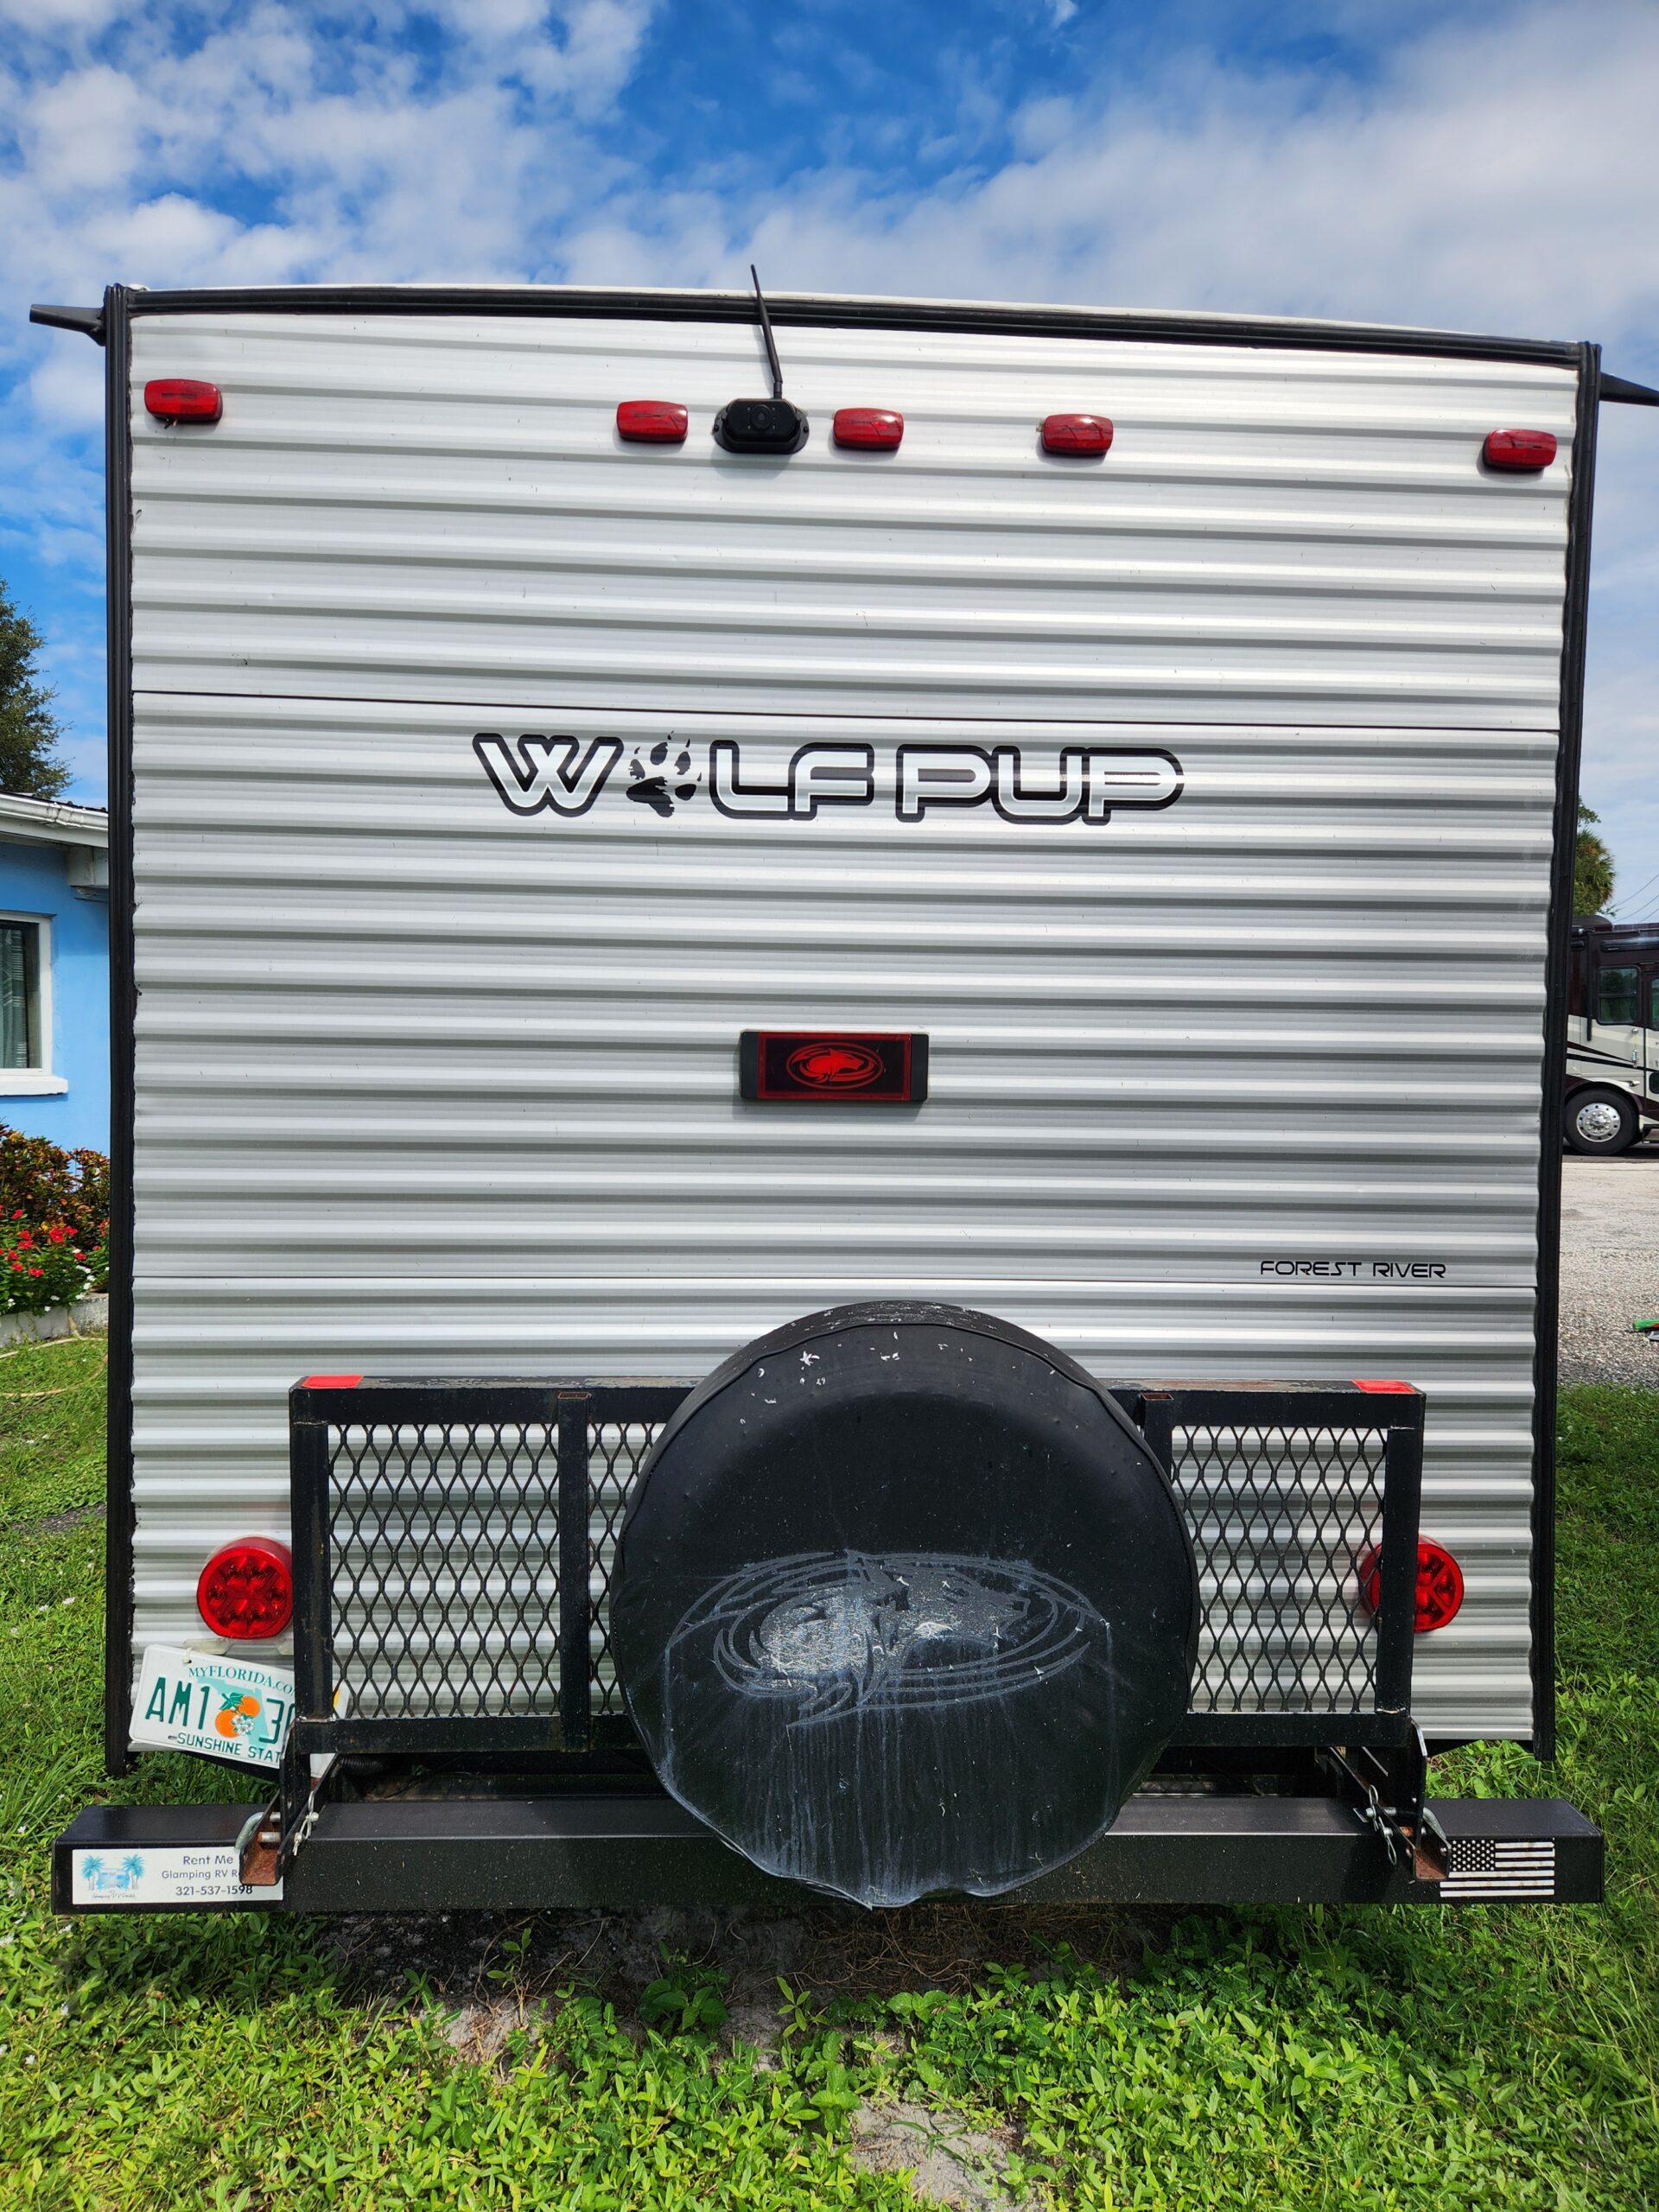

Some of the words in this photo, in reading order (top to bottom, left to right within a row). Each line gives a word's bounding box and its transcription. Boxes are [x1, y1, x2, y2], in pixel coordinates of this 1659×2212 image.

[895, 744, 1185, 825] PUP
[1260, 1260, 1363, 1277] FOREST
[1372, 1262, 1447, 1279] RIVER
[144, 1676, 211, 1730] AM1
[176, 1732, 243, 1756] SUNSHINE
[247, 1746, 282, 1764] STAT
[182, 1855, 211, 1866] Rent
[213, 1855, 234, 1865] Me
[161, 1870, 211, 1880] Glamping
[214, 1869, 228, 1878] RV
[175, 1885, 253, 1896] 321-537-1598
